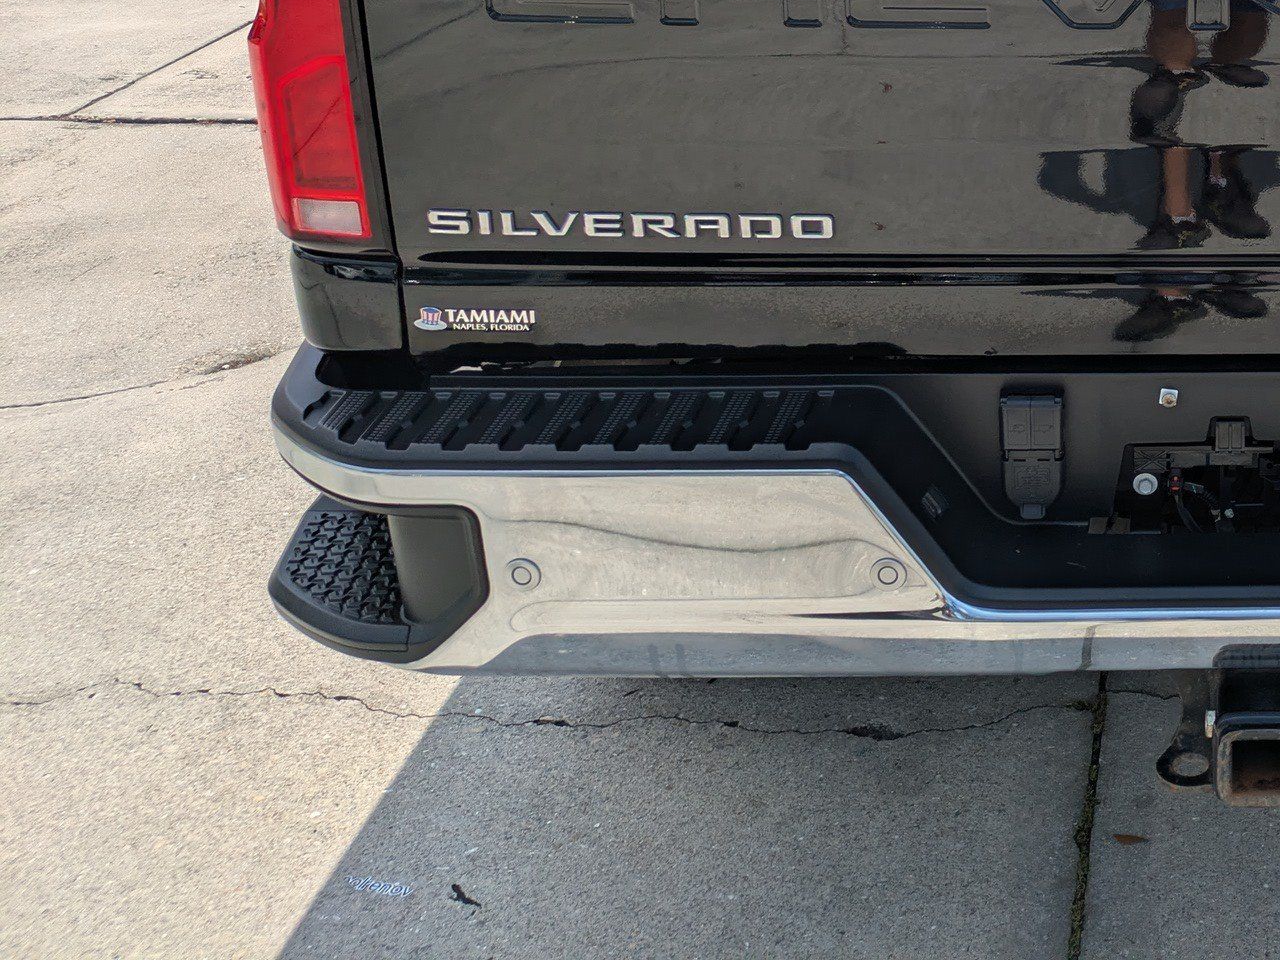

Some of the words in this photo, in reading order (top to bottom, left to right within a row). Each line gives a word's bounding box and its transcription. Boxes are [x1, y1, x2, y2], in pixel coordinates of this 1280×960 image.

[427, 208, 836, 239] SILVERADO
[444, 308, 536, 324] TAMIAMI
[452, 323, 489, 332] NAPLES,
[490, 323, 530, 332] FLORIDA
